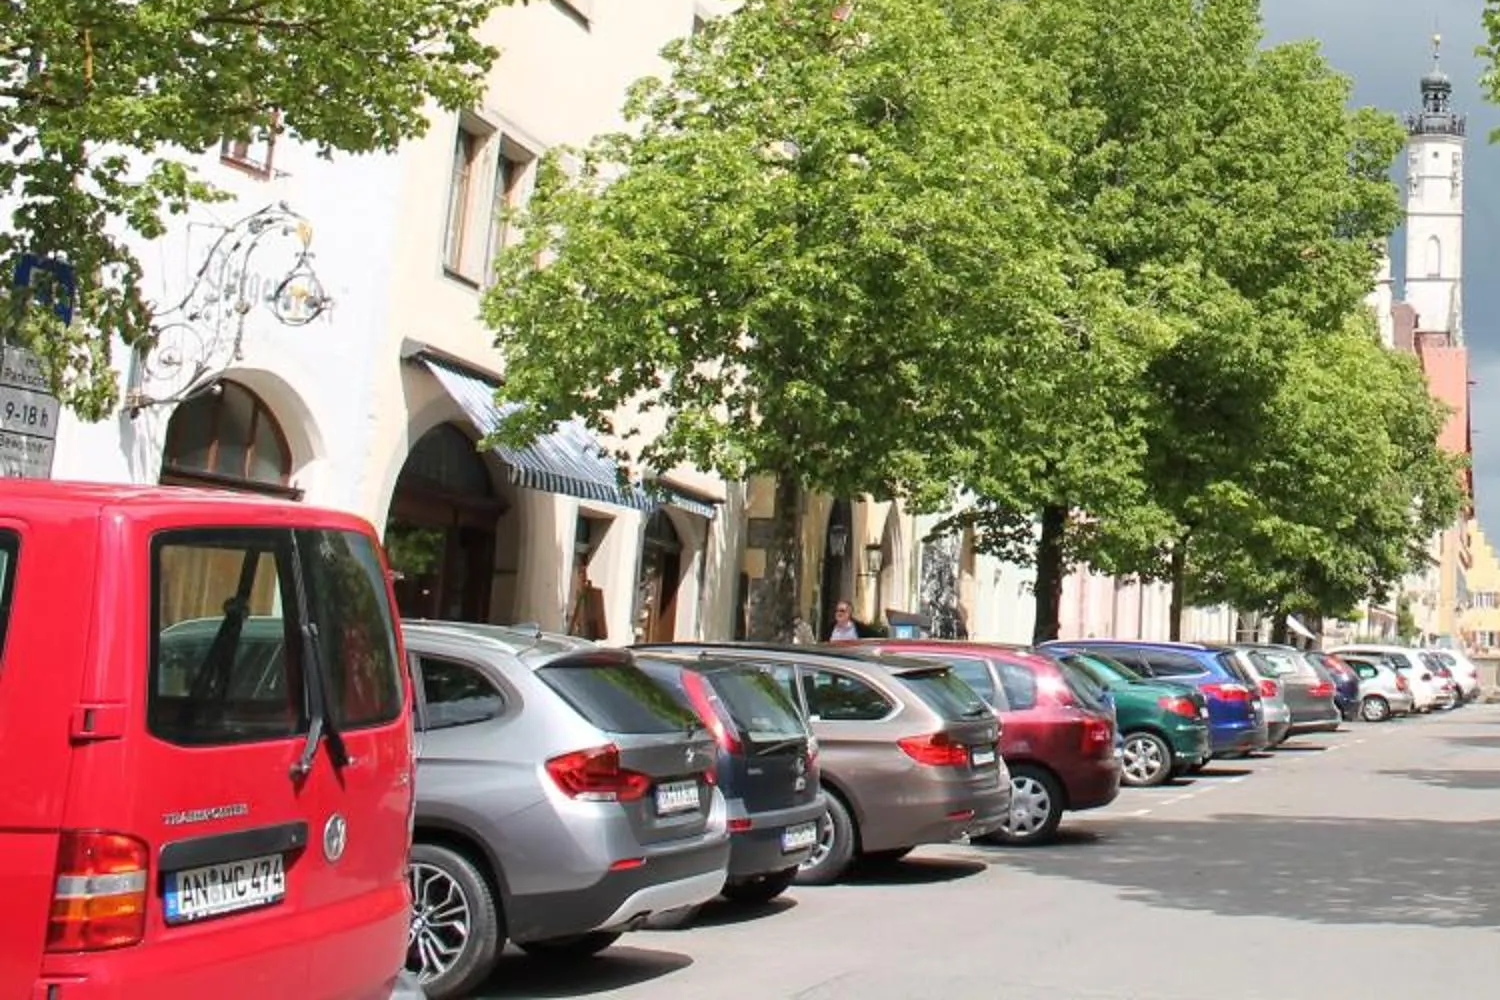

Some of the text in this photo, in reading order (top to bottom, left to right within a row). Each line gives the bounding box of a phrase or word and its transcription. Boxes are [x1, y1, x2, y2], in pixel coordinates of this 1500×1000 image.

[5, 401, 49, 429] 9-18 h
[181, 871, 210, 910] AN
[250, 858, 283, 892] 474
